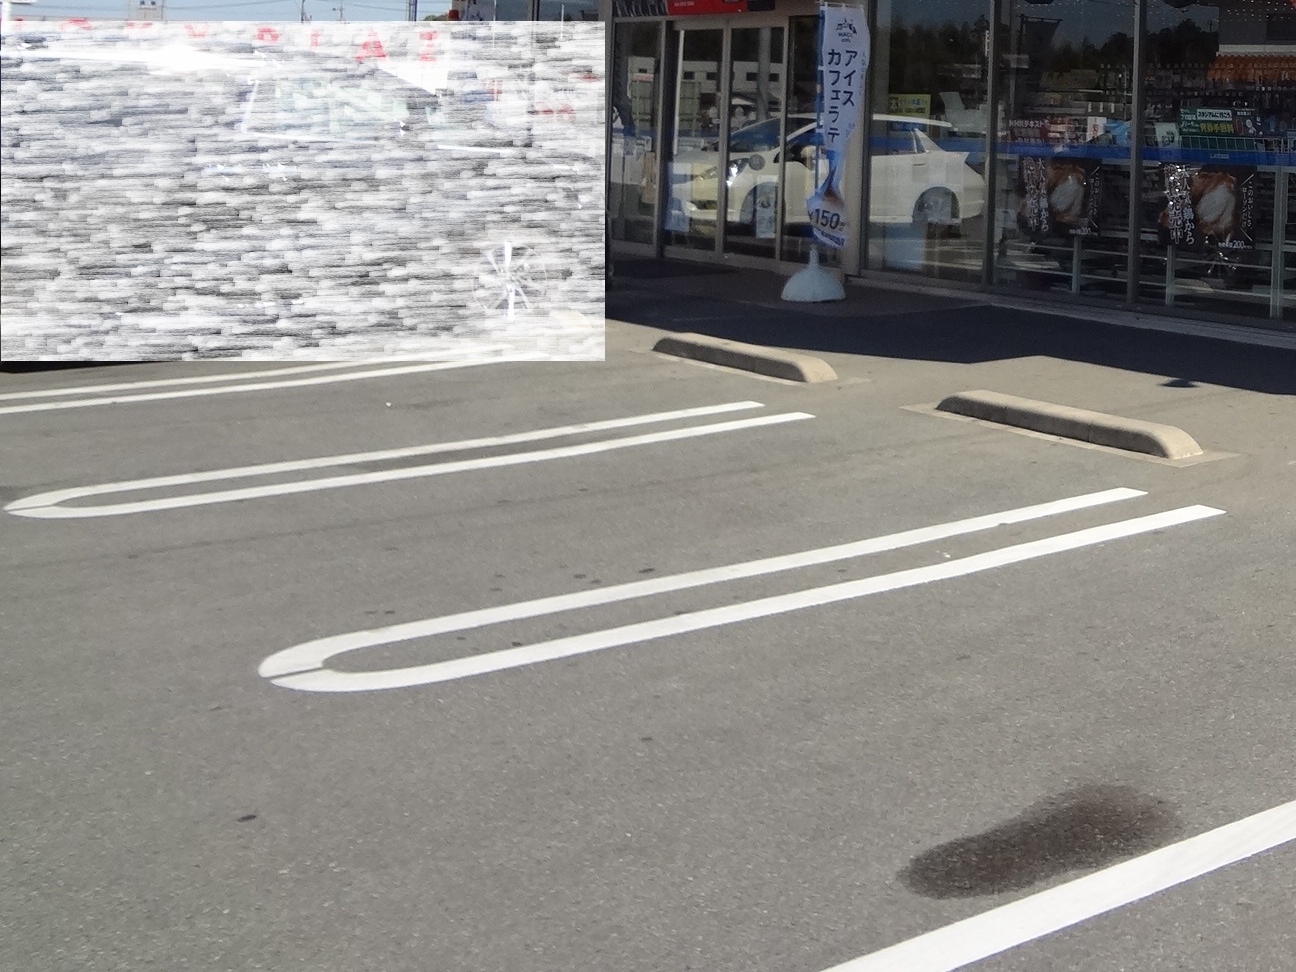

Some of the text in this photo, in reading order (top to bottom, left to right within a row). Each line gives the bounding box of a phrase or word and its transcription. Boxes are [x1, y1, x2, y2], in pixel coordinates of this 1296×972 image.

[827, 49, 842, 143] カフェラテ
[842, 49, 858, 107] アイス
